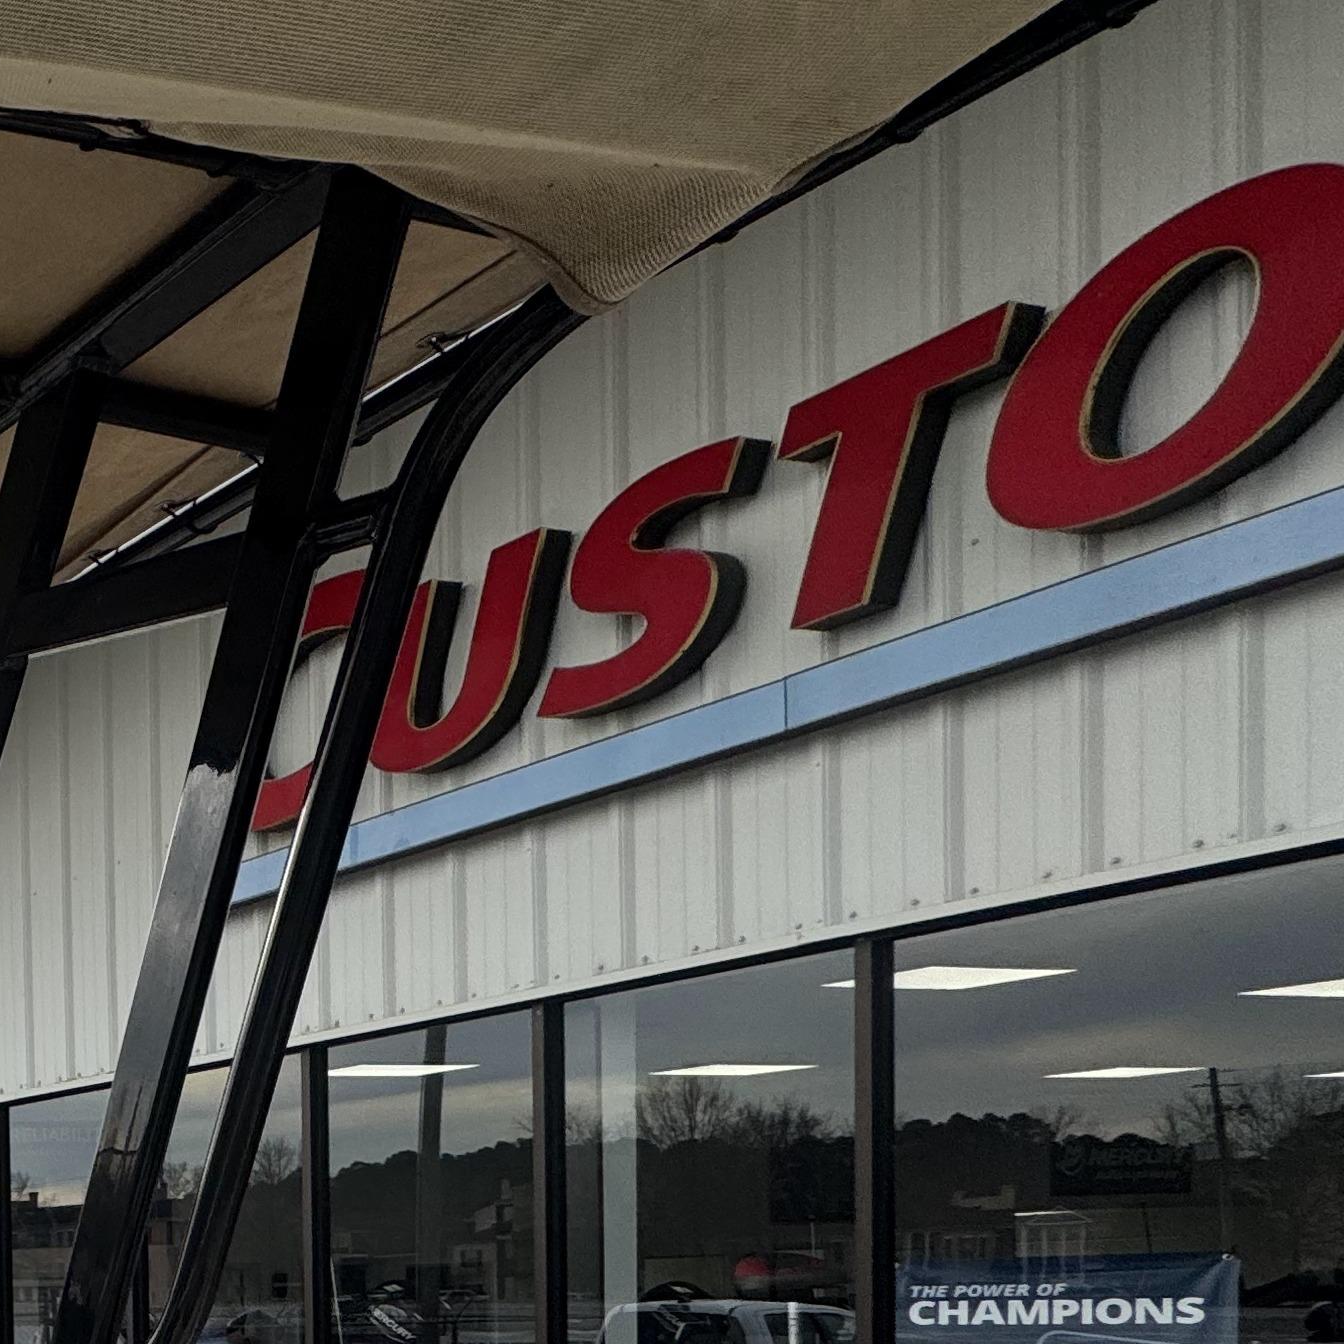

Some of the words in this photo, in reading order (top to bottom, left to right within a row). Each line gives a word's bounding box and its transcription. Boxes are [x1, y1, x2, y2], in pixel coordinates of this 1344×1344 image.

[911, 1286, 948, 1298] THE
[955, 1285, 1030, 1298] POWER
[1037, 1284, 1067, 1297] OF
[373, 1307, 416, 1340] ERCURY
[909, 1298, 1205, 1325] CHAMPIONS
